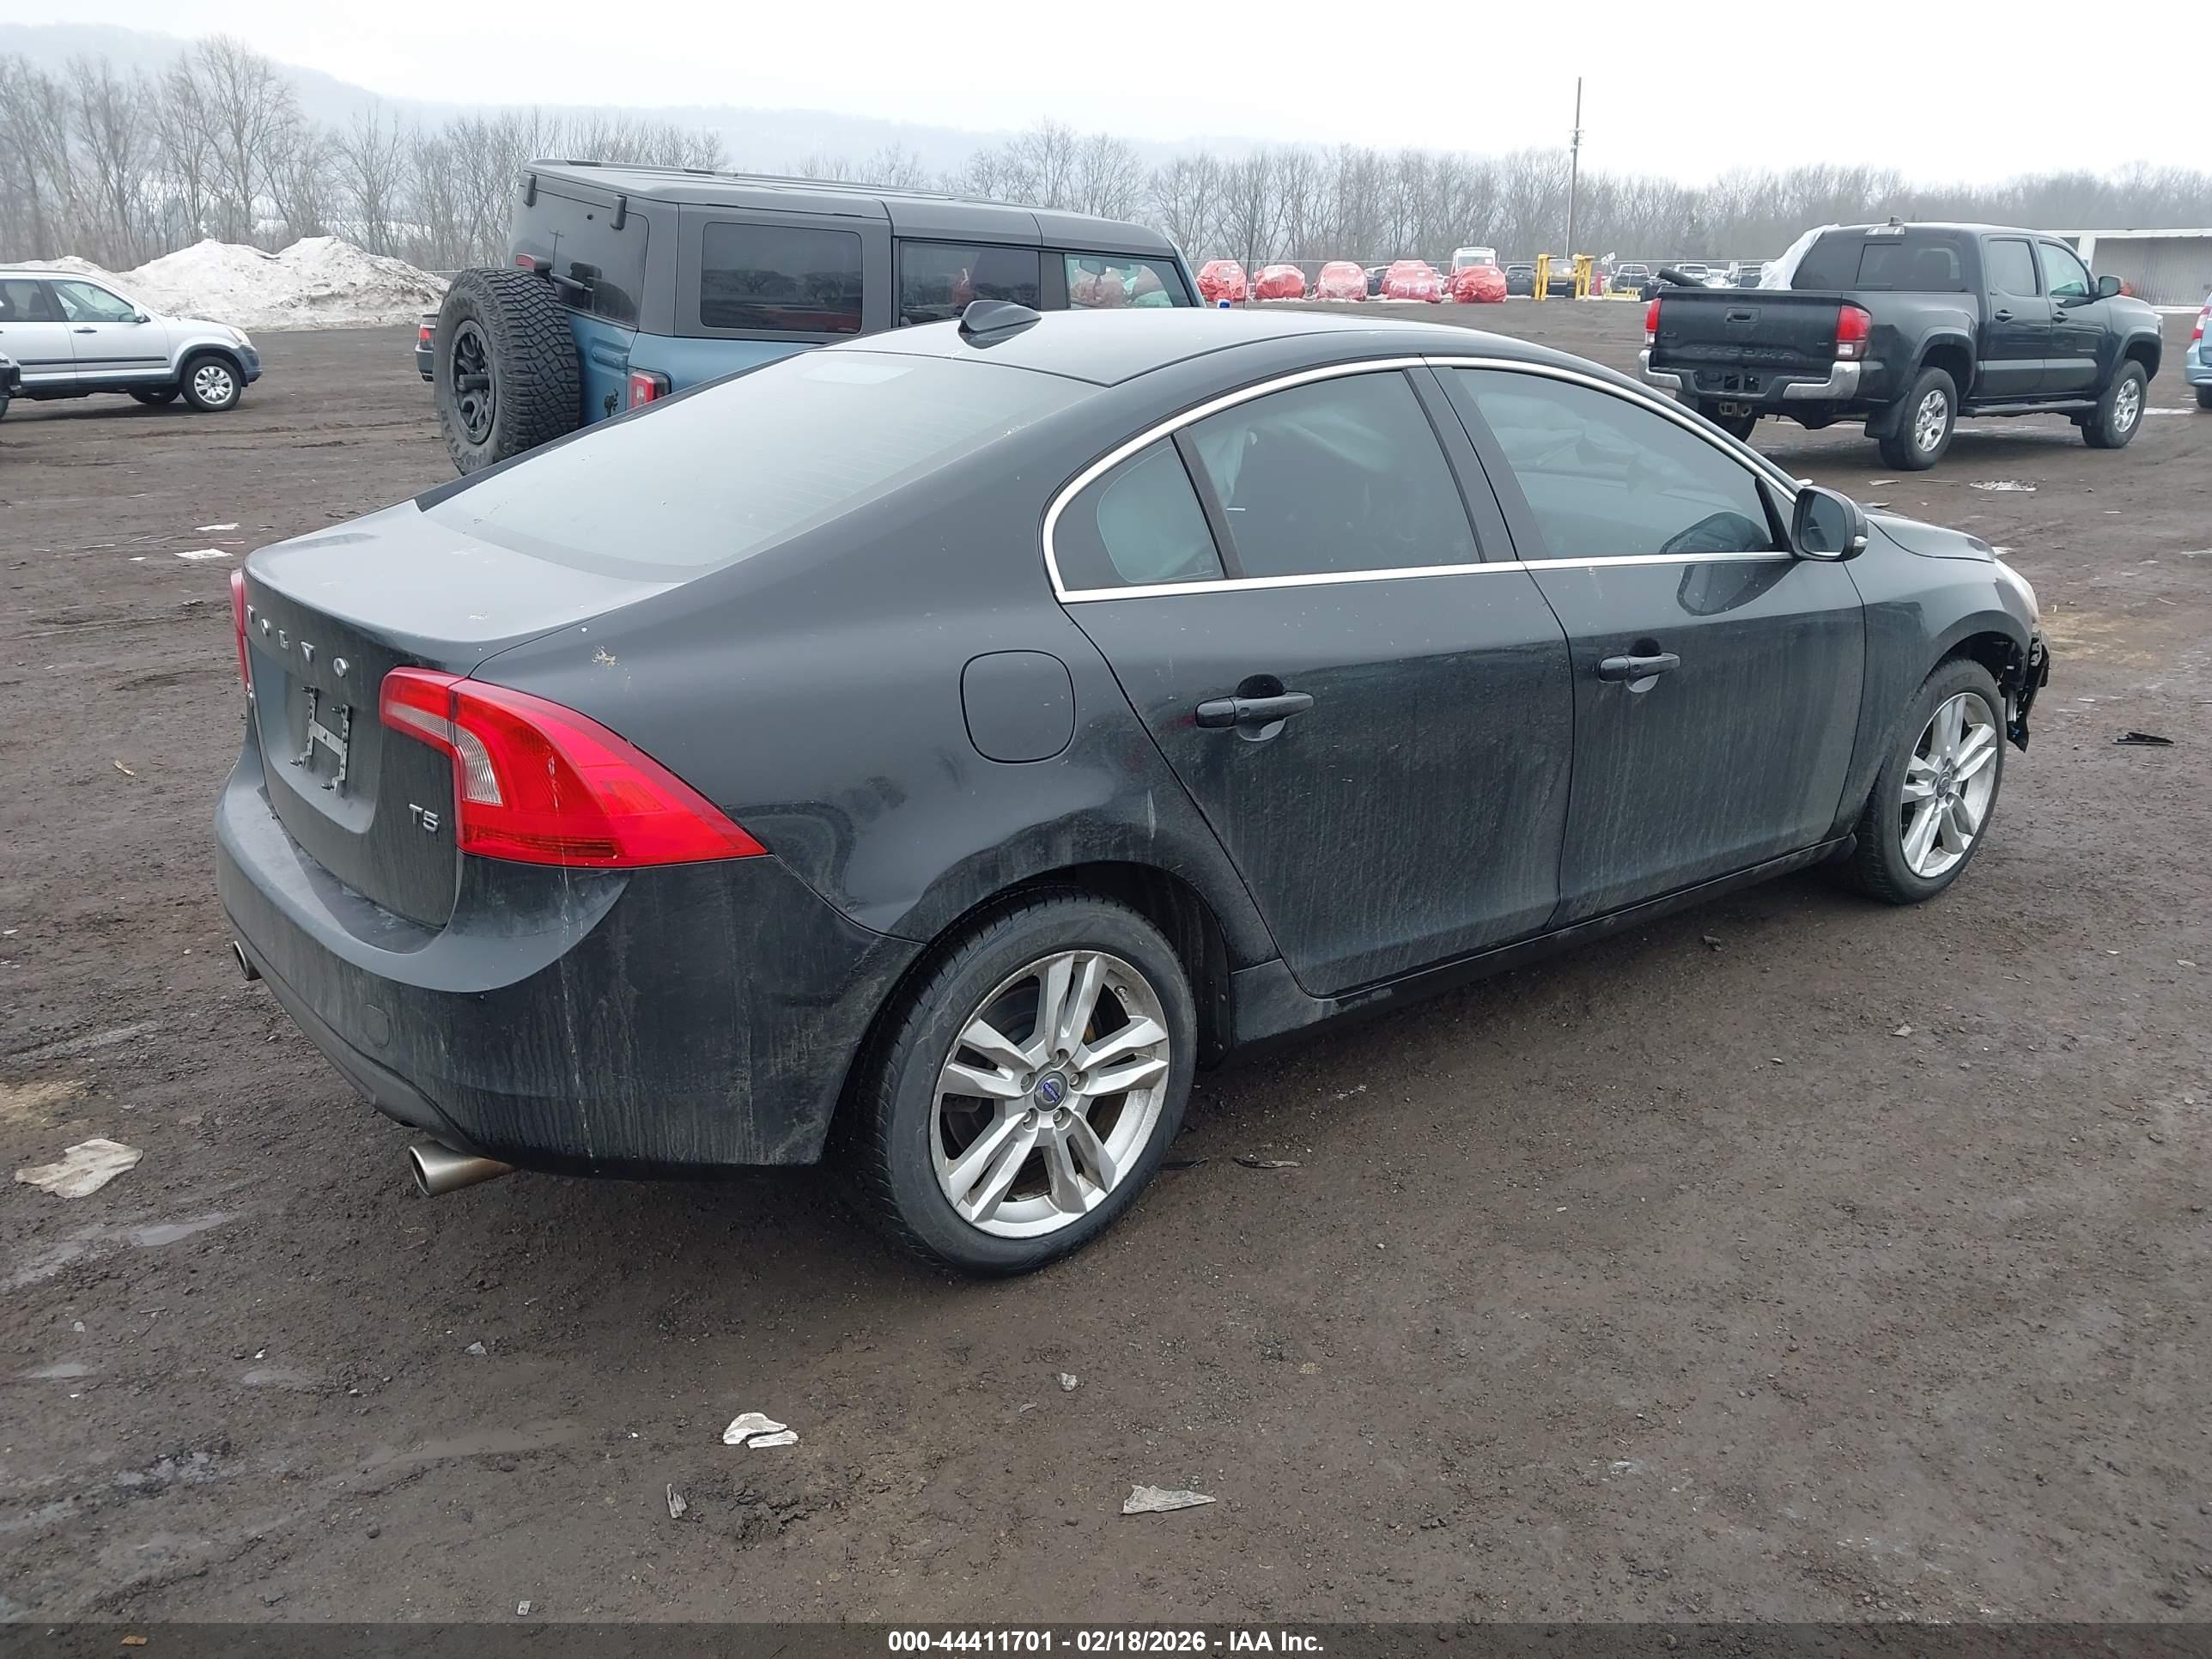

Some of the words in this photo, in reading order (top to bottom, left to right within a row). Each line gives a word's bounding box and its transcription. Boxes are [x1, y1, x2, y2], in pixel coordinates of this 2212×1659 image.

[1691, 344, 1794, 360] TACOMA
[246, 604, 350, 678] VOLVO
[407, 803, 440, 833] T5
